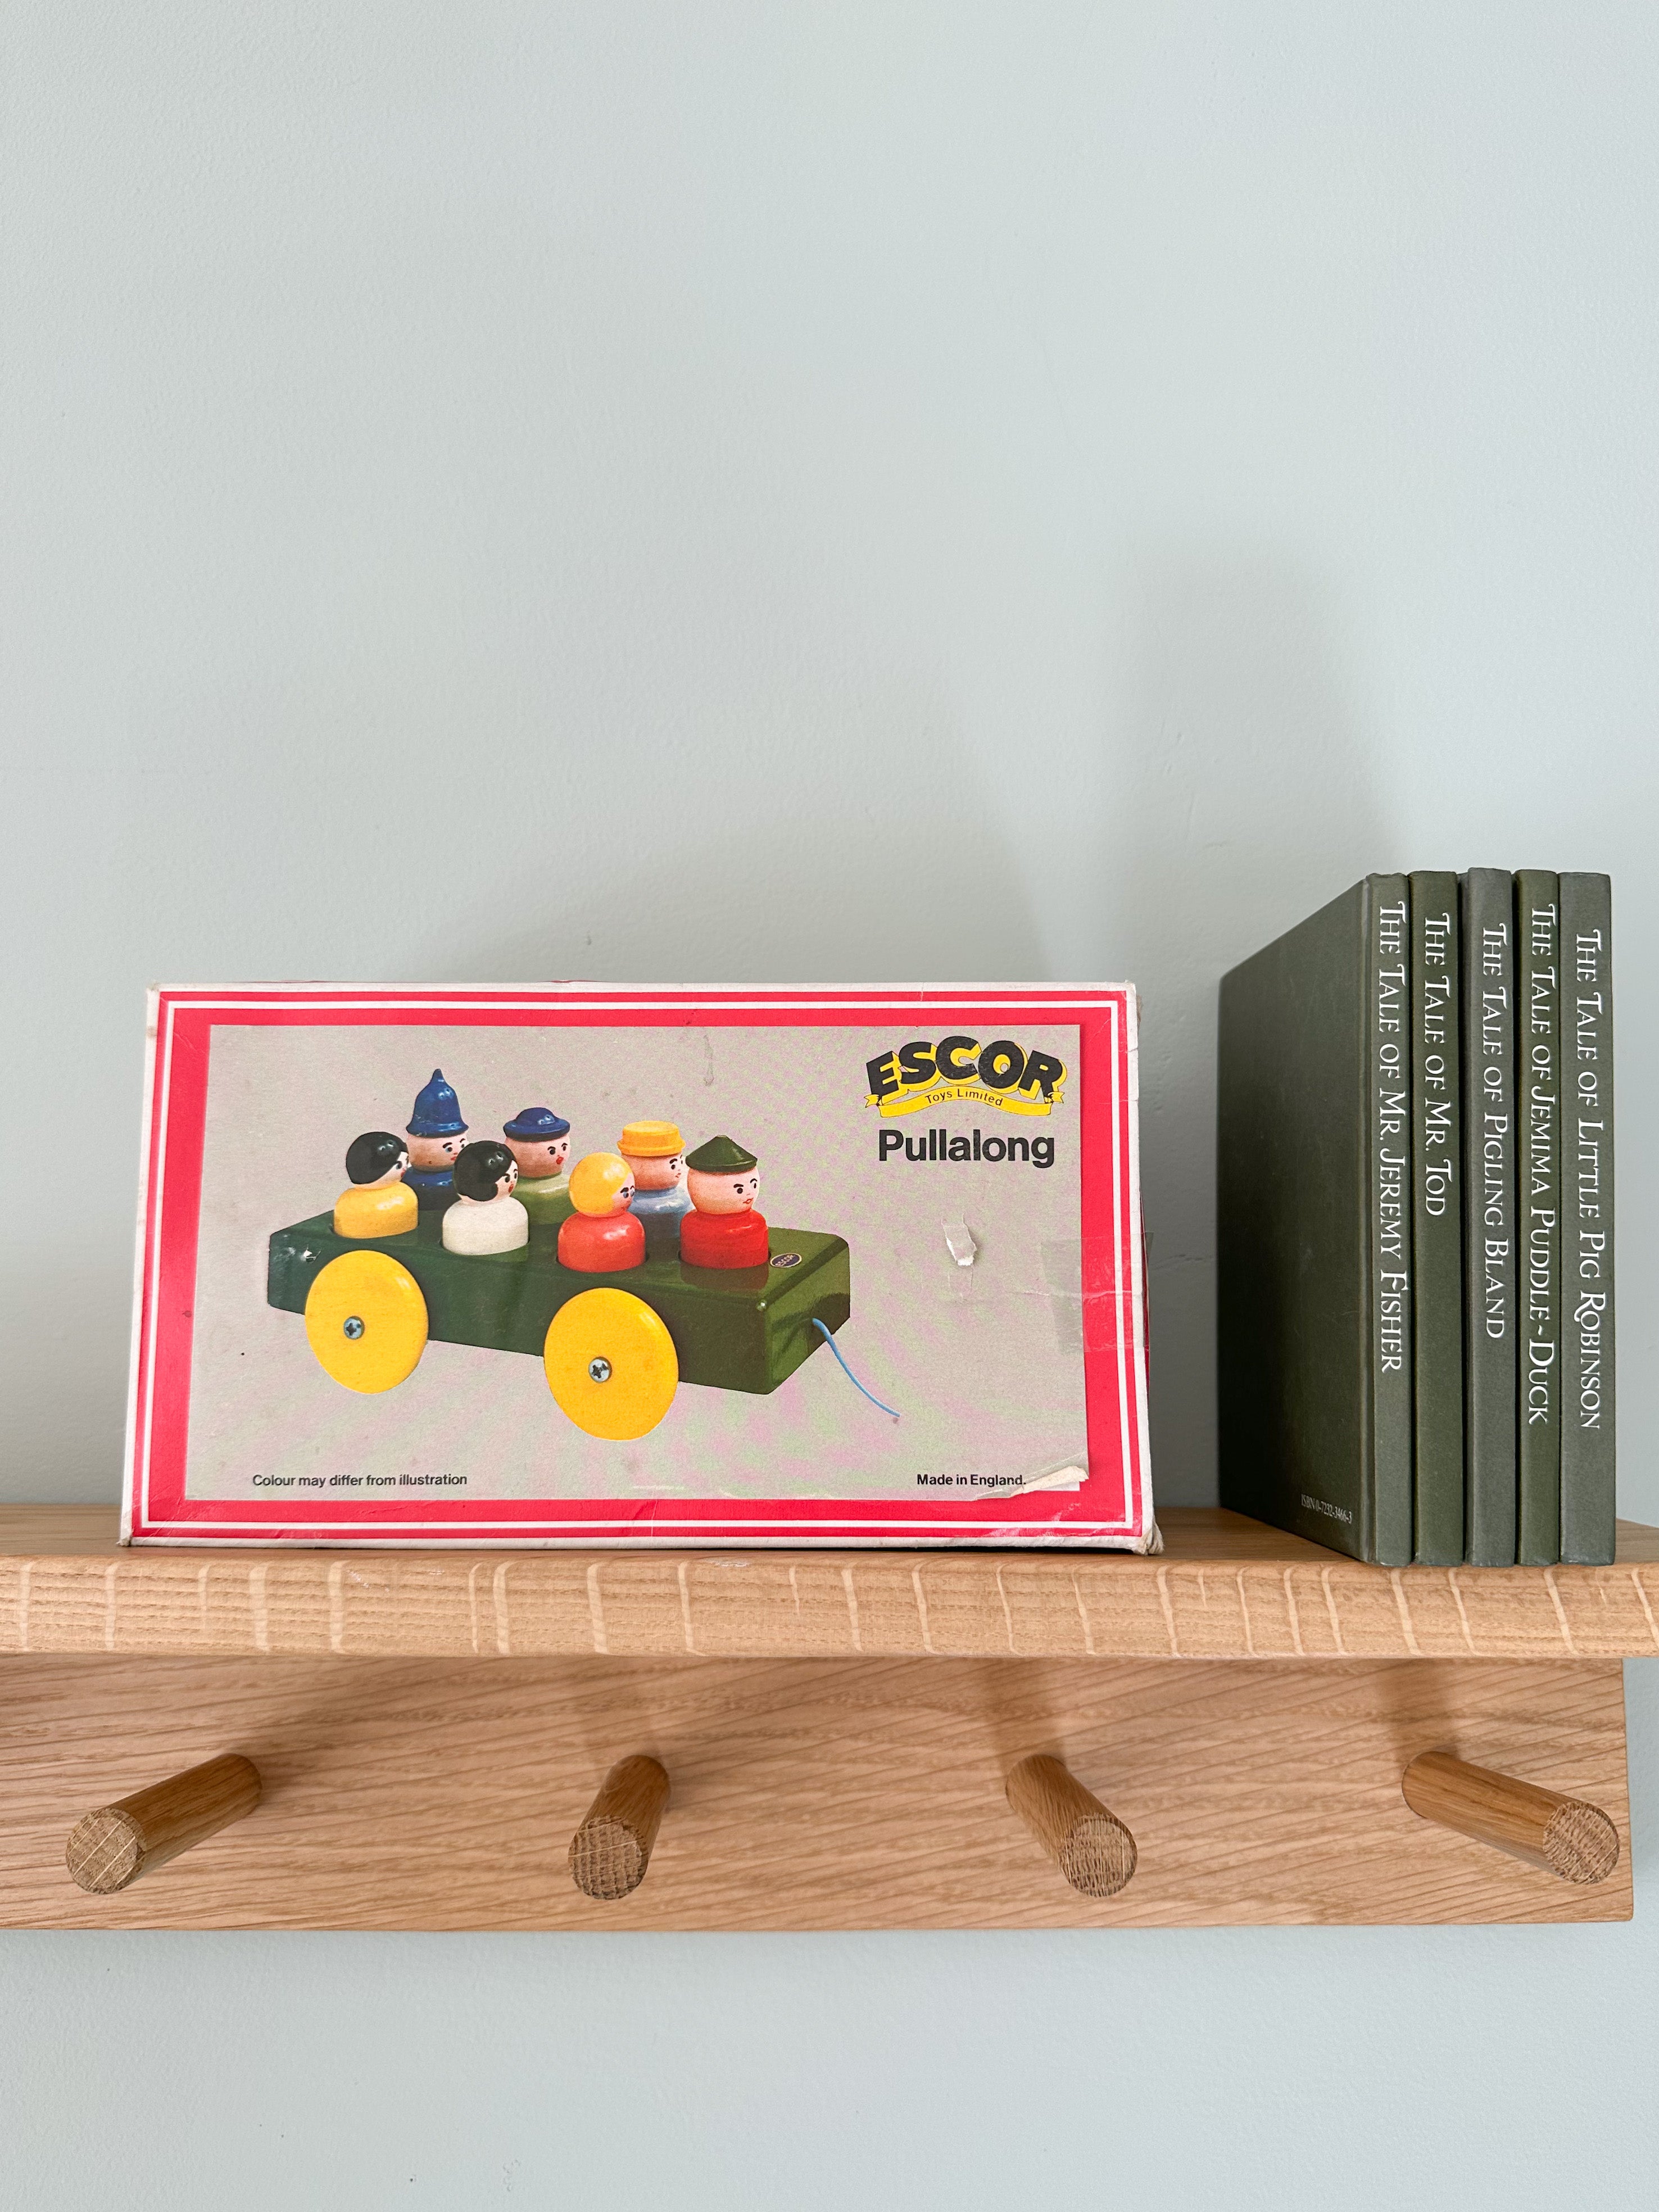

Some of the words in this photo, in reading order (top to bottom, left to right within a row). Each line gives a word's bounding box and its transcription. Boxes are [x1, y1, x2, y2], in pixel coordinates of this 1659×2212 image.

[1379, 900, 1407, 954] THE
[1425, 912, 1451, 966] THE
[1483, 923, 1508, 976] THE
[1531, 903, 1556, 956] THE
[1576, 928, 1602, 982] THE
[1379, 963, 1406, 1032] TALE
[1424, 975, 1451, 1044] TALE
[1483, 986, 1507, 1055] TALE
[1531, 966, 1556, 1034] TALE
[1576, 991, 1603, 1060] TALE
[865, 1036, 1066, 1100] ESCOR
[1379, 1043, 1400, 1079] OF
[1425, 1055, 1445, 1090] OF
[1483, 1066, 1503, 1102] OF
[1531, 1045, 1552, 1080] OF
[924, 1091, 953, 1104] Toys
[958, 1087, 1004, 1107] Limited
[1379, 1087, 1406, 1141] MR.
[1578, 1071, 1599, 1107] OF
[879, 1128, 1054, 1168] Pullalong
[1425, 1097, 1451, 1152] MR.
[1530, 1085, 1556, 1196] JEMIMA
[1425, 1159, 1452, 1216] TOD
[1484, 1112, 1508, 1227] PIGLING
[1578, 1117, 1603, 1218] LITTLE
[1379, 1148, 1406, 1260] JEREMY
[1579, 1230, 1606, 1279] PIG
[1485, 1237, 1509, 1338] BLAND
[1380, 1269, 1407, 1374] FISHER
[1574, 1290, 1606, 1429] ROBINSON
[252, 1475, 296, 1486] Colour
[298, 1477, 326, 1488] may
[329, 1475, 364, 1486] differ
[366, 1475, 396, 1486] from
[399, 1474, 467, 1485] illustration
[917, 1474, 953, 1485] Made
[956, 1474, 968, 1485] in
[970, 1474, 1027, 1488] England.
